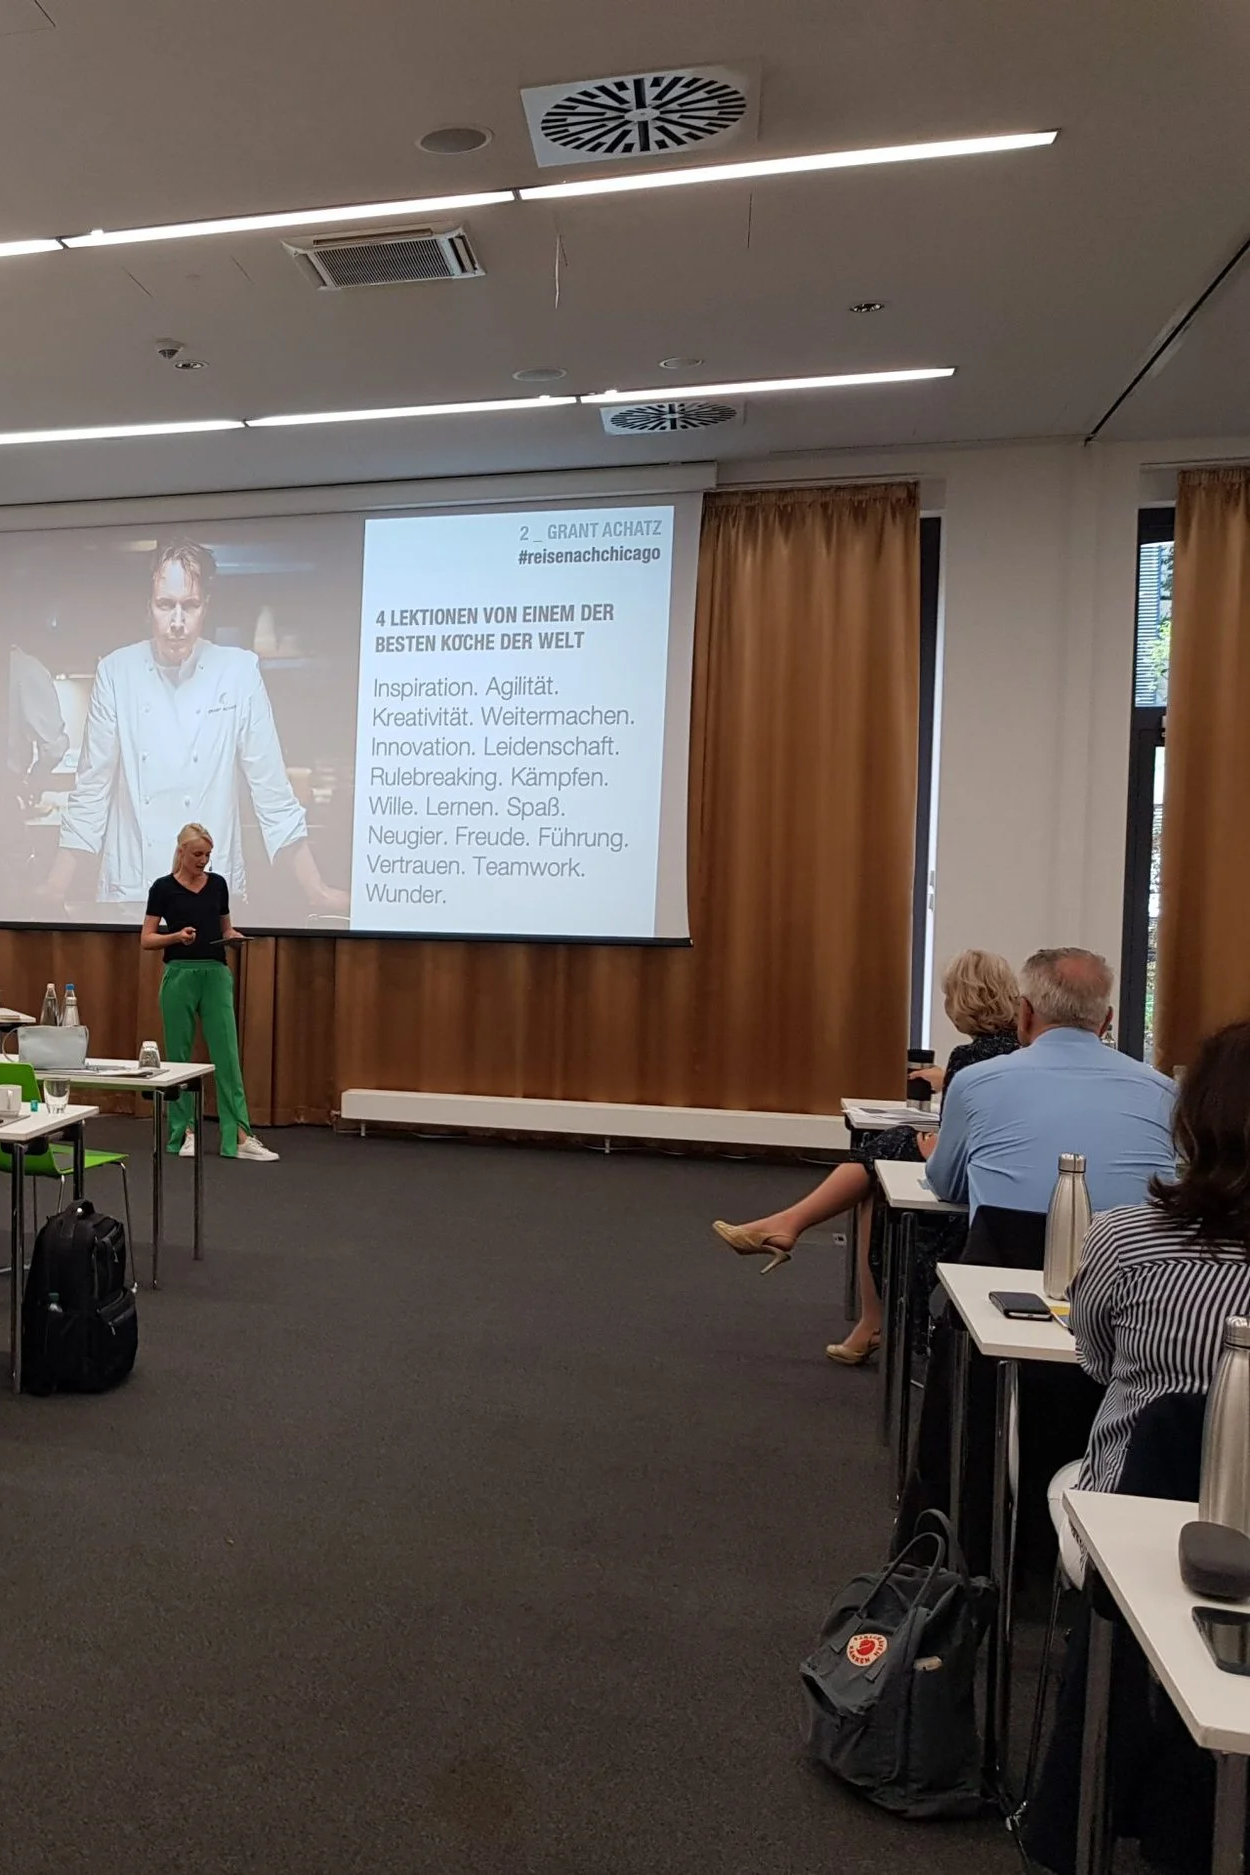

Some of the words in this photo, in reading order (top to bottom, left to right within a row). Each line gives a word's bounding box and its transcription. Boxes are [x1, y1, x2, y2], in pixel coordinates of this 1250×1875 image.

[519, 526, 530, 542] 2
[547, 523, 599, 541] GRANT
[602, 520, 663, 538] ACHATZ
[518, 546, 661, 566] #reisenachchicago
[376, 610, 386, 628] 4
[390, 608, 479, 628] LEKTIONEN
[483, 606, 518, 625] VON
[523, 604, 575, 624] EINEM
[580, 603, 615, 623] DER
[375, 635, 437, 654] BESTEN
[441, 633, 496, 653] KÖCHE
[500, 633, 533, 651] DER
[538, 631, 585, 650] WELT
[373, 678, 479, 702] Inspiration.
[486, 676, 559, 701] Agilität.
[372, 708, 474, 728] Kreativität.
[481, 706, 636, 727] Weitermachen.
[372, 737, 476, 758] Innovation.
[484, 736, 620, 757] Leidenschaft.
[370, 766, 503, 792] Rulebreaking.
[511, 767, 609, 792] Kämpfen.
[369, 796, 419, 817] Wille.
[426, 797, 499, 818] Lernen.
[506, 797, 566, 821] Spaß.
[368, 825, 448, 850] Neugier.
[455, 826, 531, 848] Freude.
[539, 827, 629, 853] Führung.
[367, 855, 466, 876] Vertrauen.
[473, 856, 586, 878] Teamwork.
[366, 884, 447, 905] Wunder.
